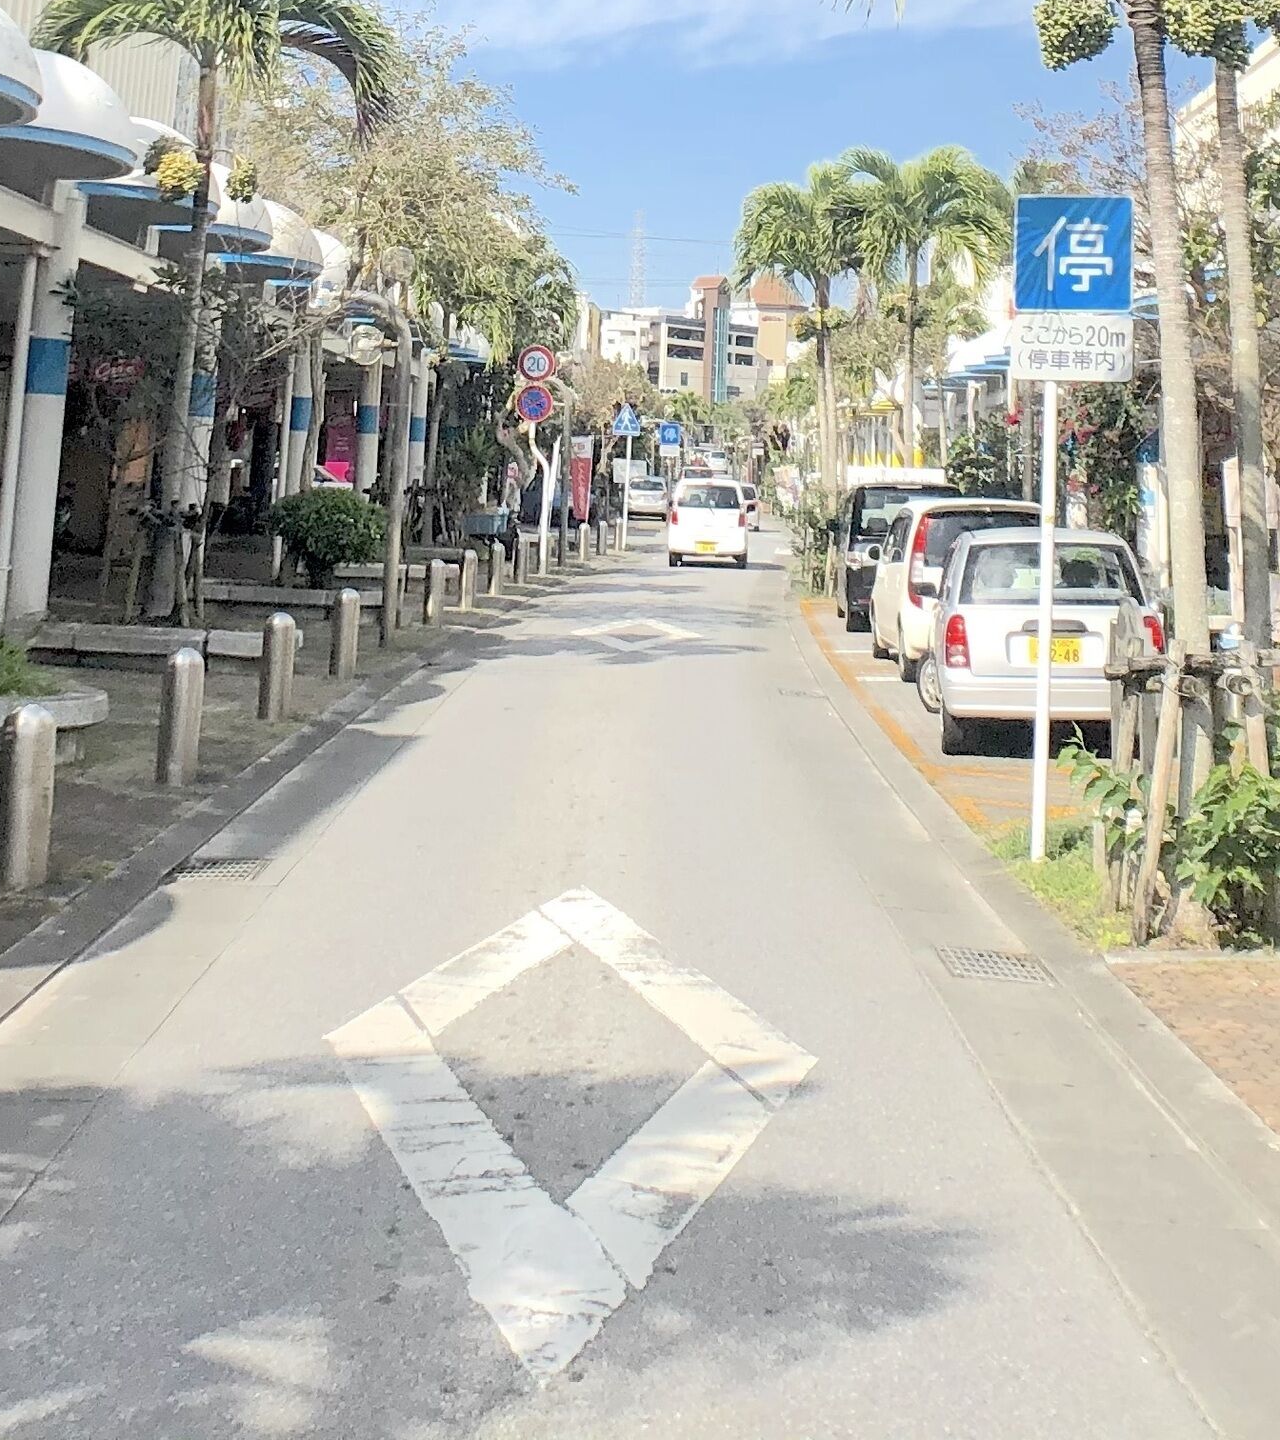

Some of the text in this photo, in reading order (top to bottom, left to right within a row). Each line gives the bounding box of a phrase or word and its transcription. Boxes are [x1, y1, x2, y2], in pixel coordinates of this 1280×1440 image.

[1033, 216, 1114, 292] 停
[1021, 325, 1126, 347] ここから20m
[527, 356, 546, 372] 20
[1017, 349, 1126, 371] (停車帯内)
